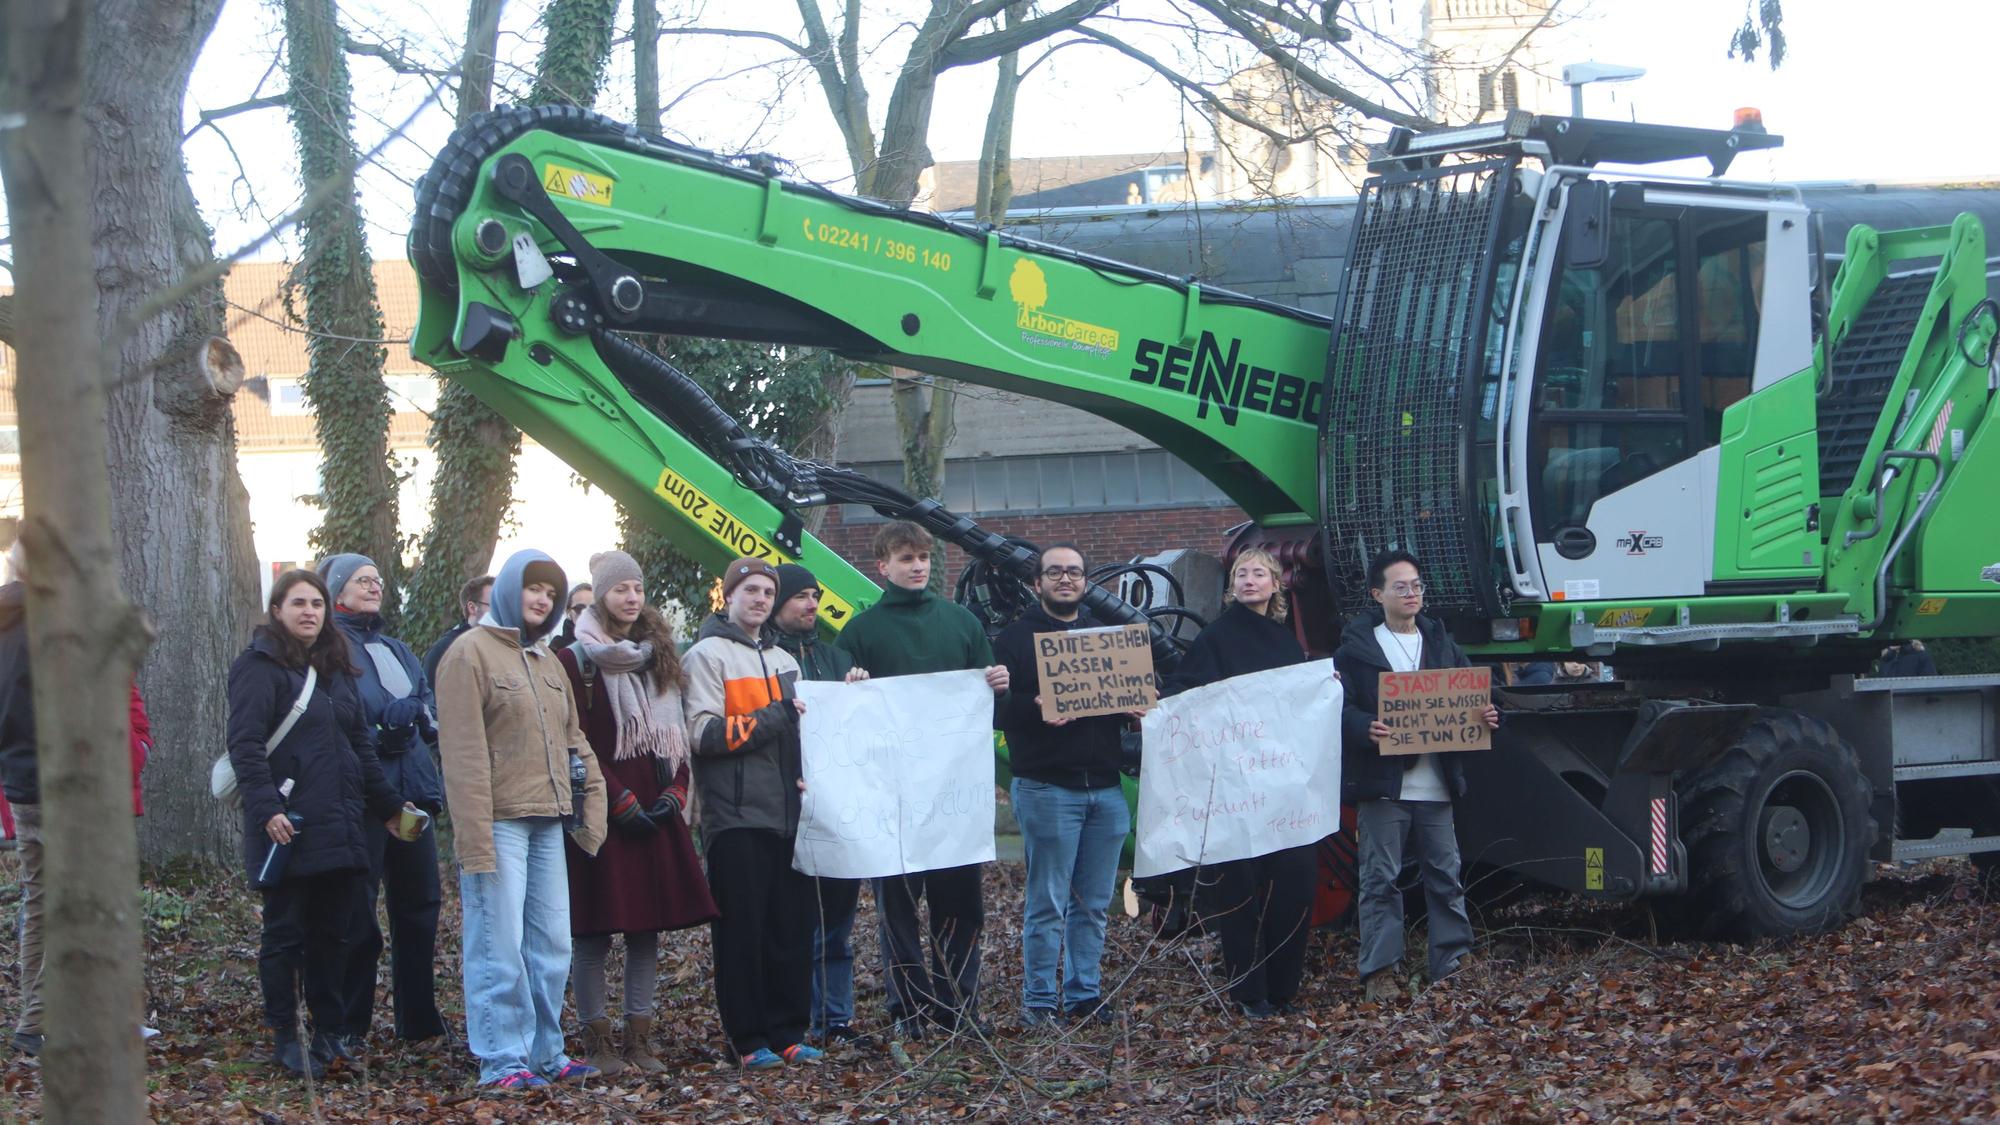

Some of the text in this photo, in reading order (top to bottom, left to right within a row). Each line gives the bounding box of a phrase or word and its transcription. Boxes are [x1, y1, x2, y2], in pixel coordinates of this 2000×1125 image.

[818, 223, 869, 252] 02241
[885, 240, 916, 263] 396
[922, 249, 951, 272] 140
[664, 474, 773, 558] ZONE 20m
[1040, 629, 1150, 657] BITTE STEHEN
[1045, 656, 1114, 677] LASSEN
[1051, 673, 1155, 695] Dein Klima
[1383, 669, 1489, 698] STADT KÖLN
[1056, 688, 1149, 713] braucht mich
[1383, 694, 1488, 712] DENN SIE WISSEN
[1383, 712, 1467, 728] NICHT WAS
[1390, 733, 1414, 746] SIE
[1419, 729, 1453, 745] TUN
